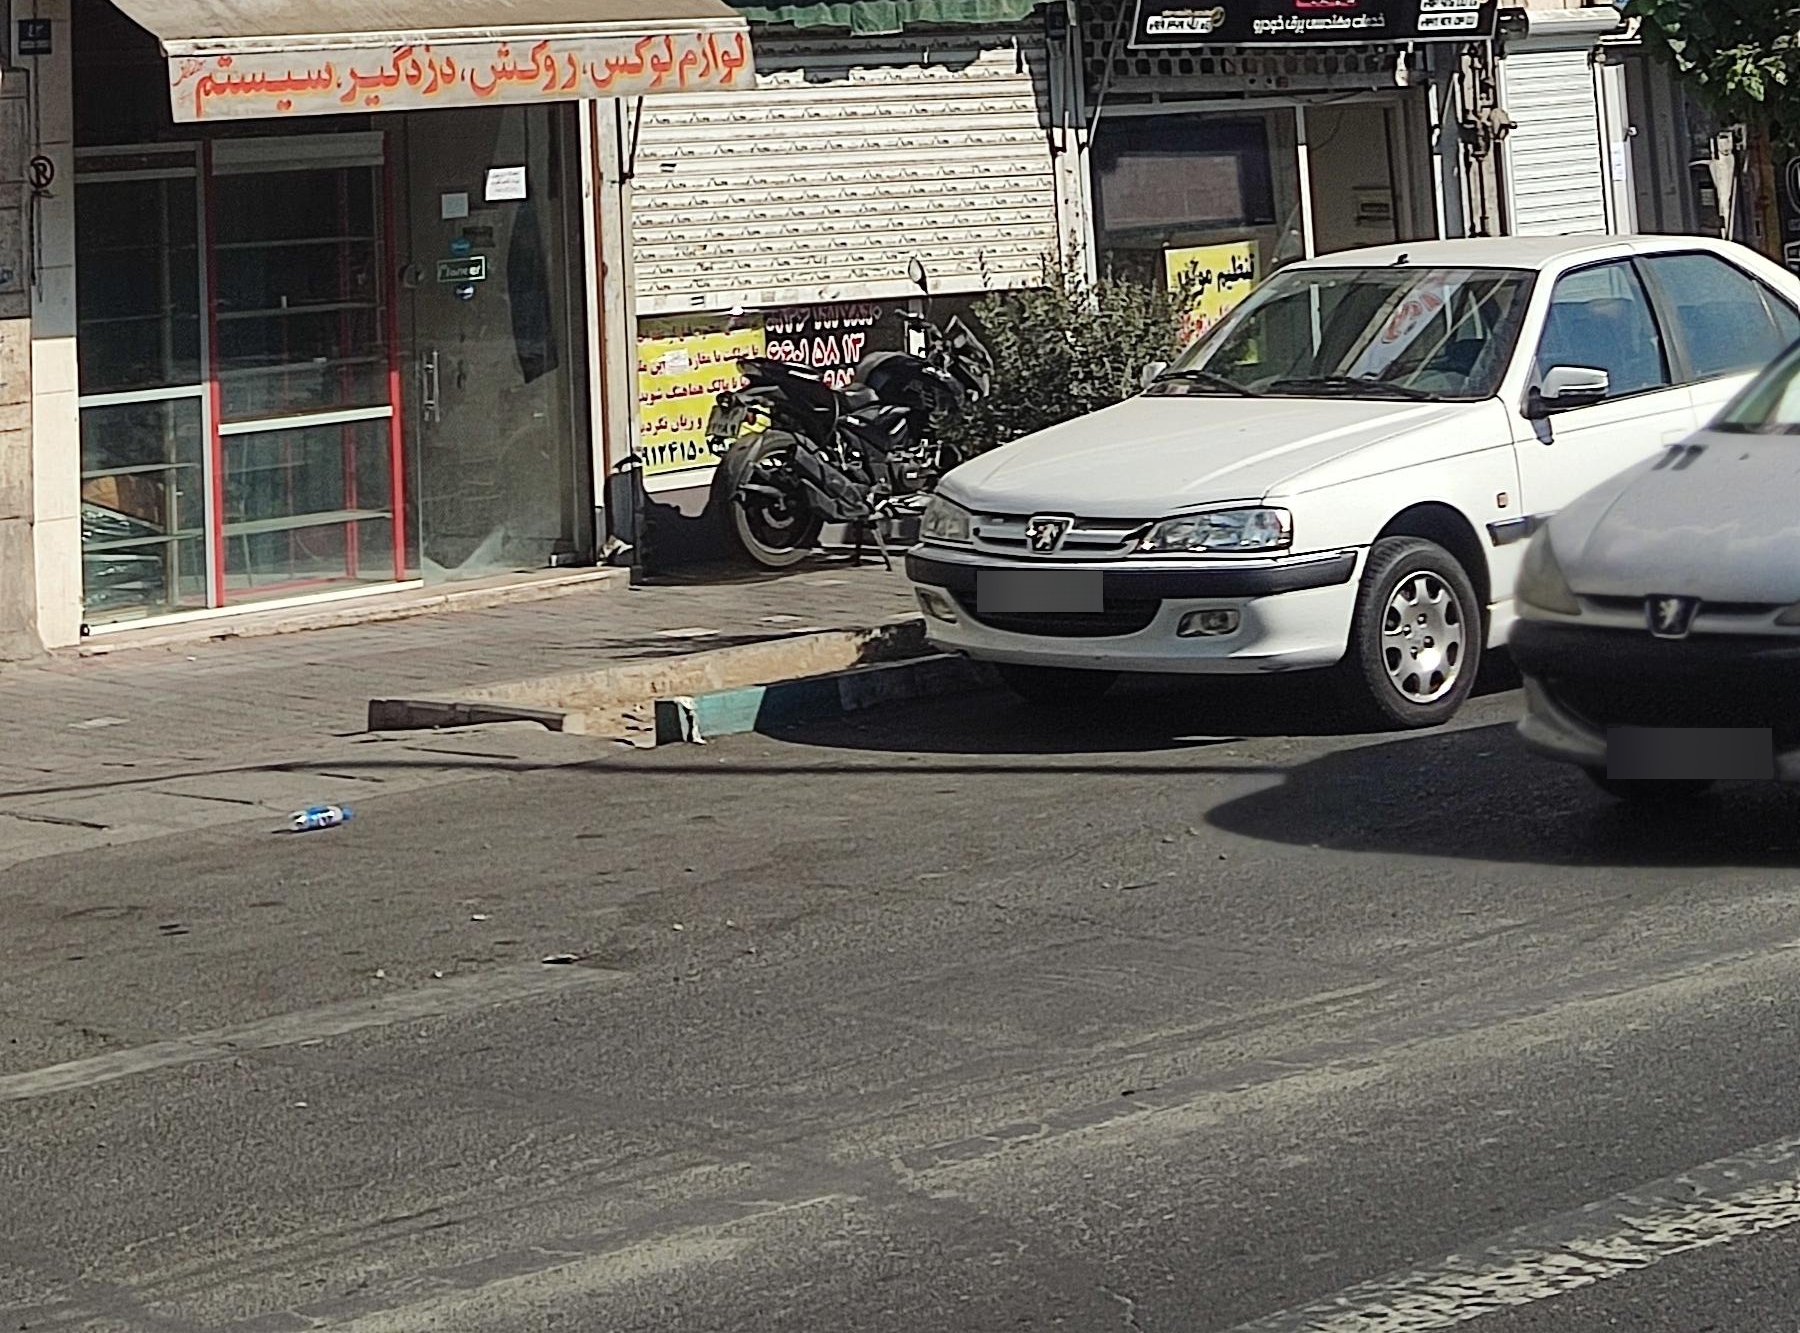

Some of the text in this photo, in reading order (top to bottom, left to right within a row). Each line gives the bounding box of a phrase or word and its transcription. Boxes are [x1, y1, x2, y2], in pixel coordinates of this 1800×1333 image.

[1253, 13, 1385, 35] خدمات مهندسی برق خودرو
[678, 32, 748, 88] لوازم
[195, 56, 334, 119] سیستم
[1217, 253, 1255, 293] تنظیم
